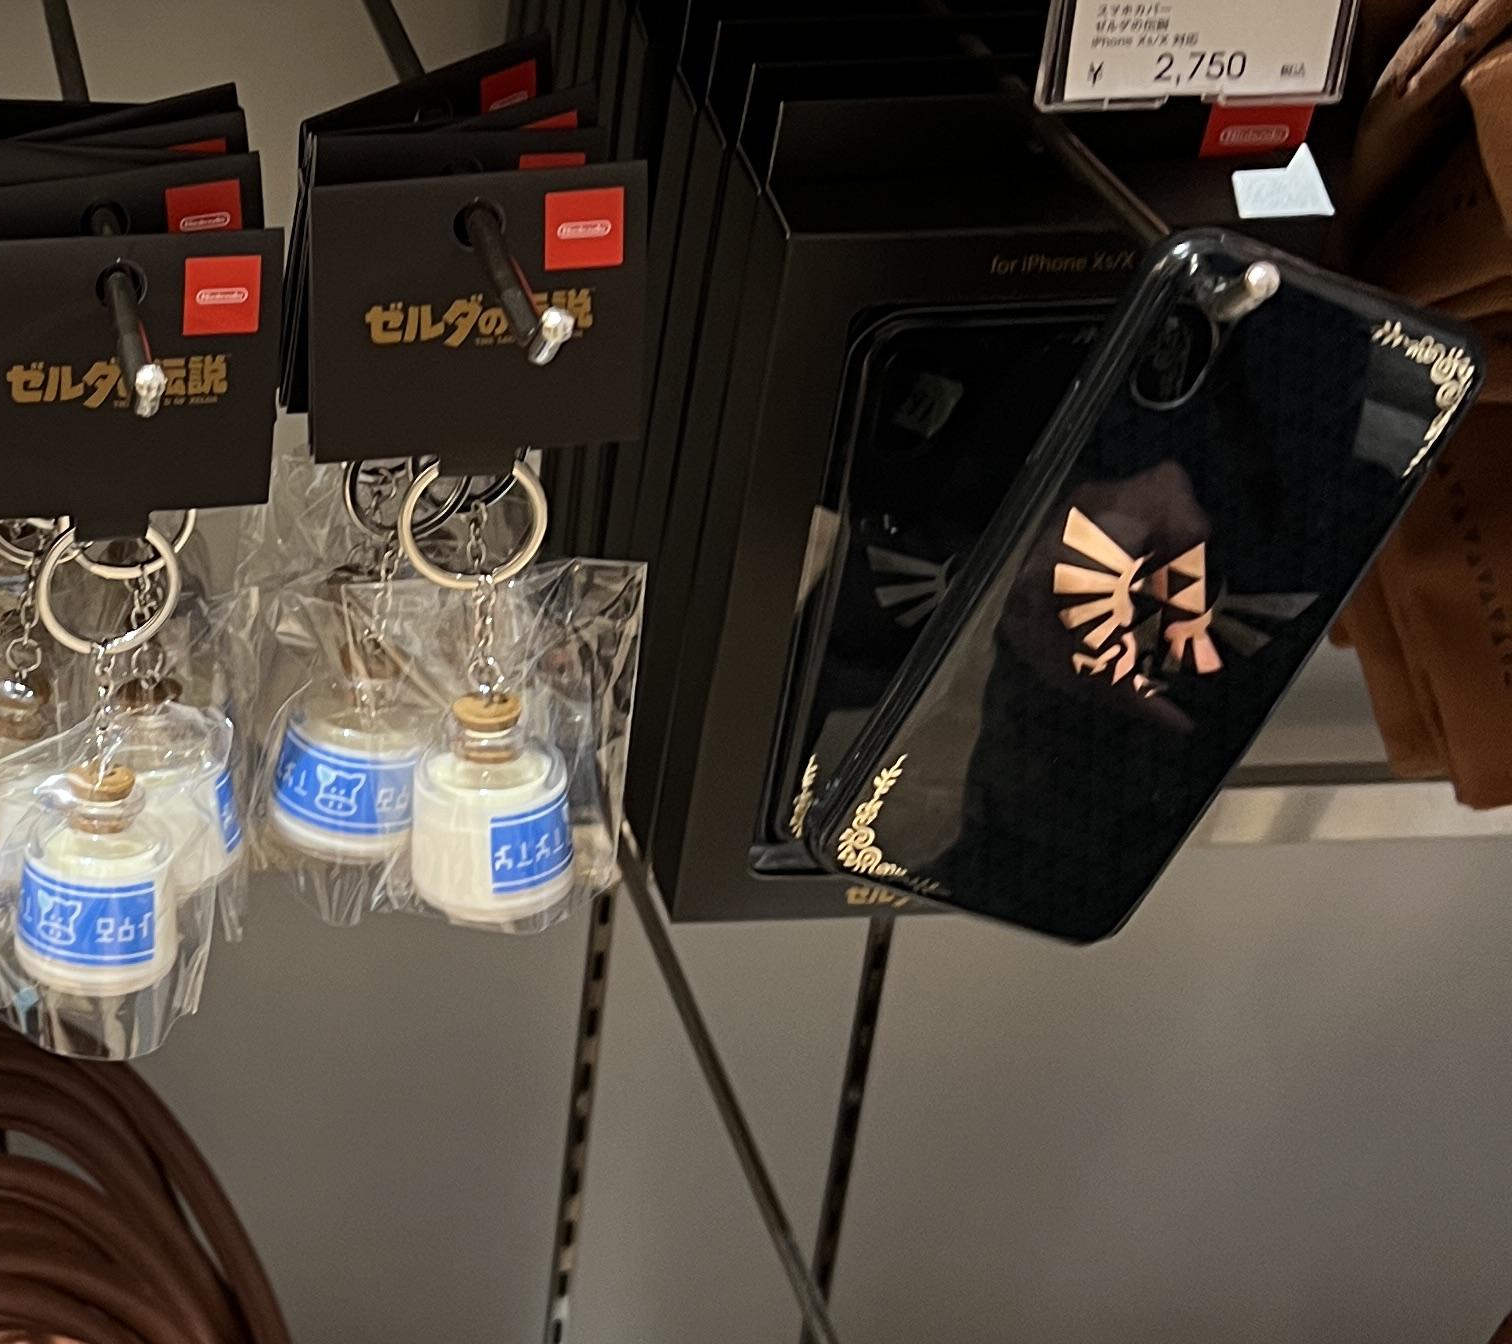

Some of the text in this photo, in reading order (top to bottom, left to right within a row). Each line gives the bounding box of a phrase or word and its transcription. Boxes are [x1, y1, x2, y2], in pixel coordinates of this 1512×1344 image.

[1153, 51, 1247, 87] 2,750
[6, 354, 228, 408] ゼルダ伝説
